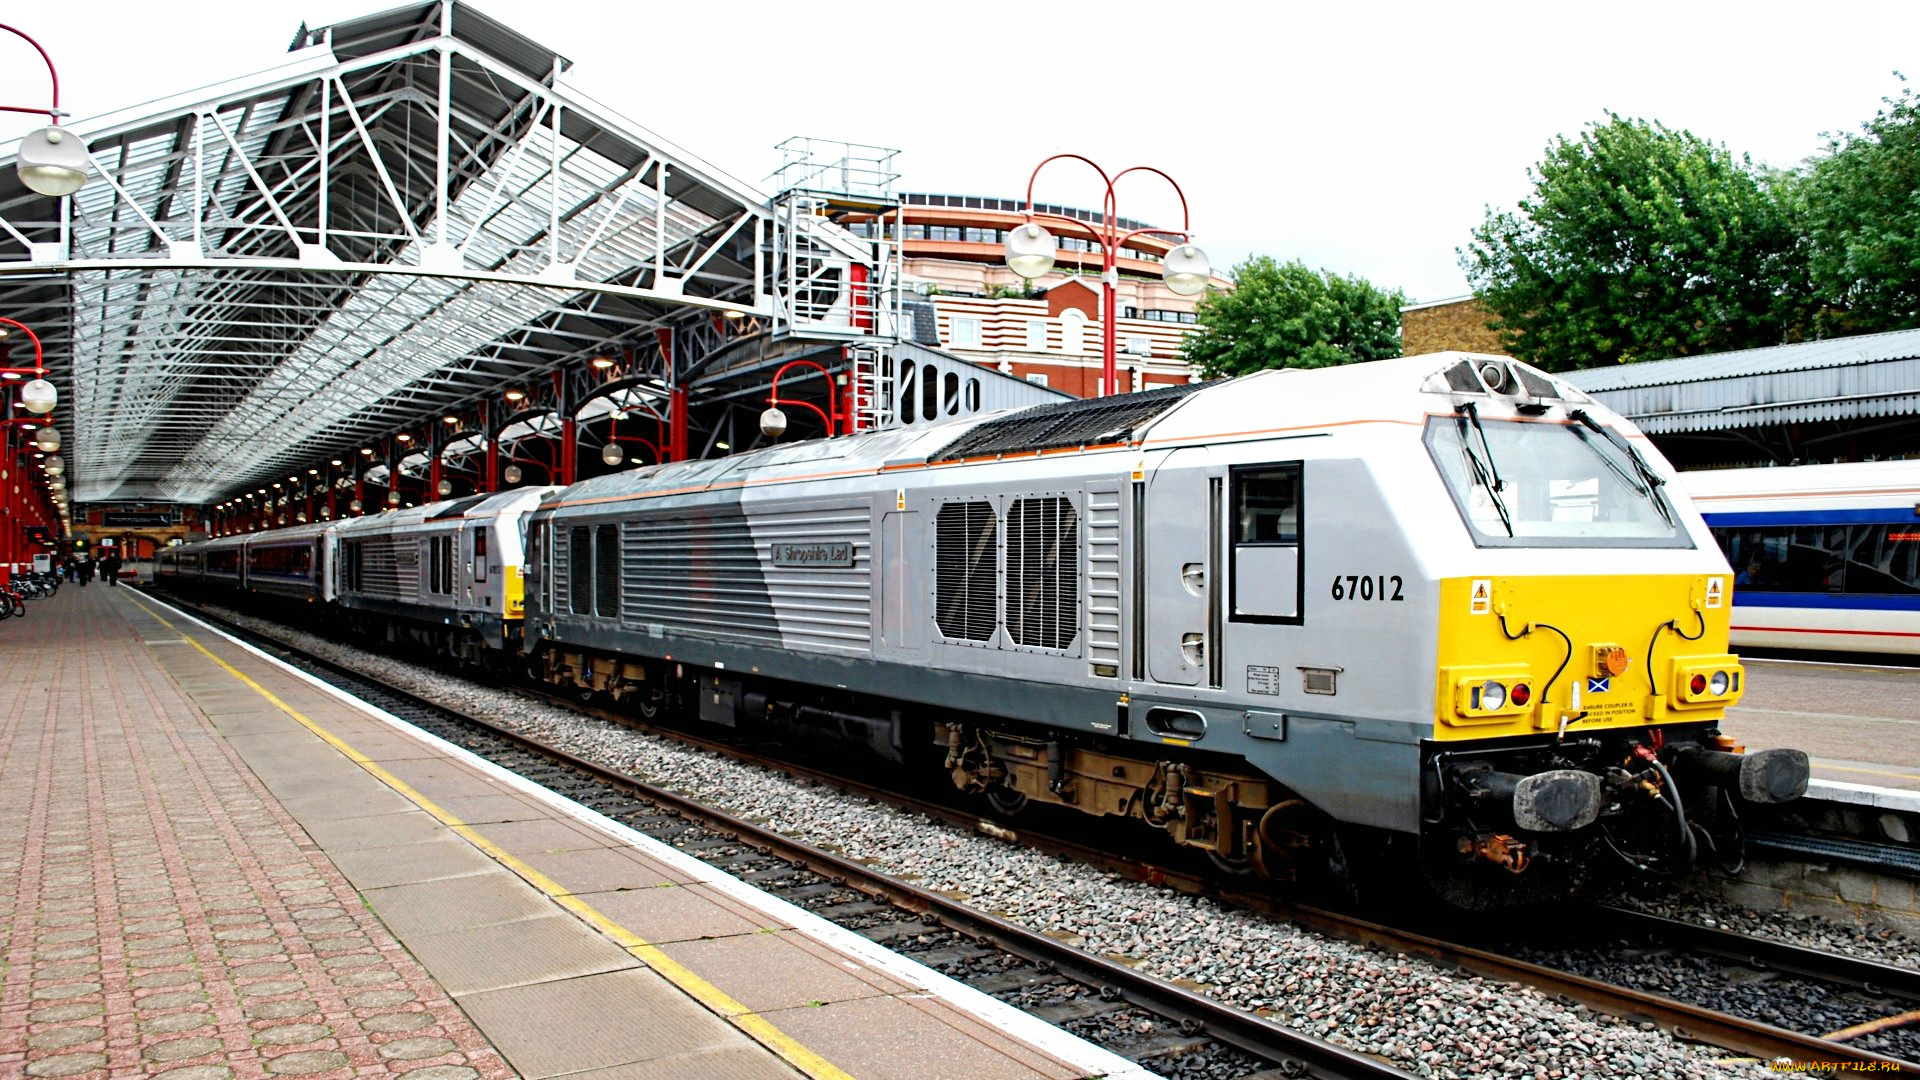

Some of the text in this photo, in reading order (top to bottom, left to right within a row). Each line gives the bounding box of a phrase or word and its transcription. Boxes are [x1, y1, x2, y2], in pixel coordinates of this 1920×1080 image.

[775, 545, 848, 563] A Shropshire Lad
[1331, 575, 1404, 601] 67012
